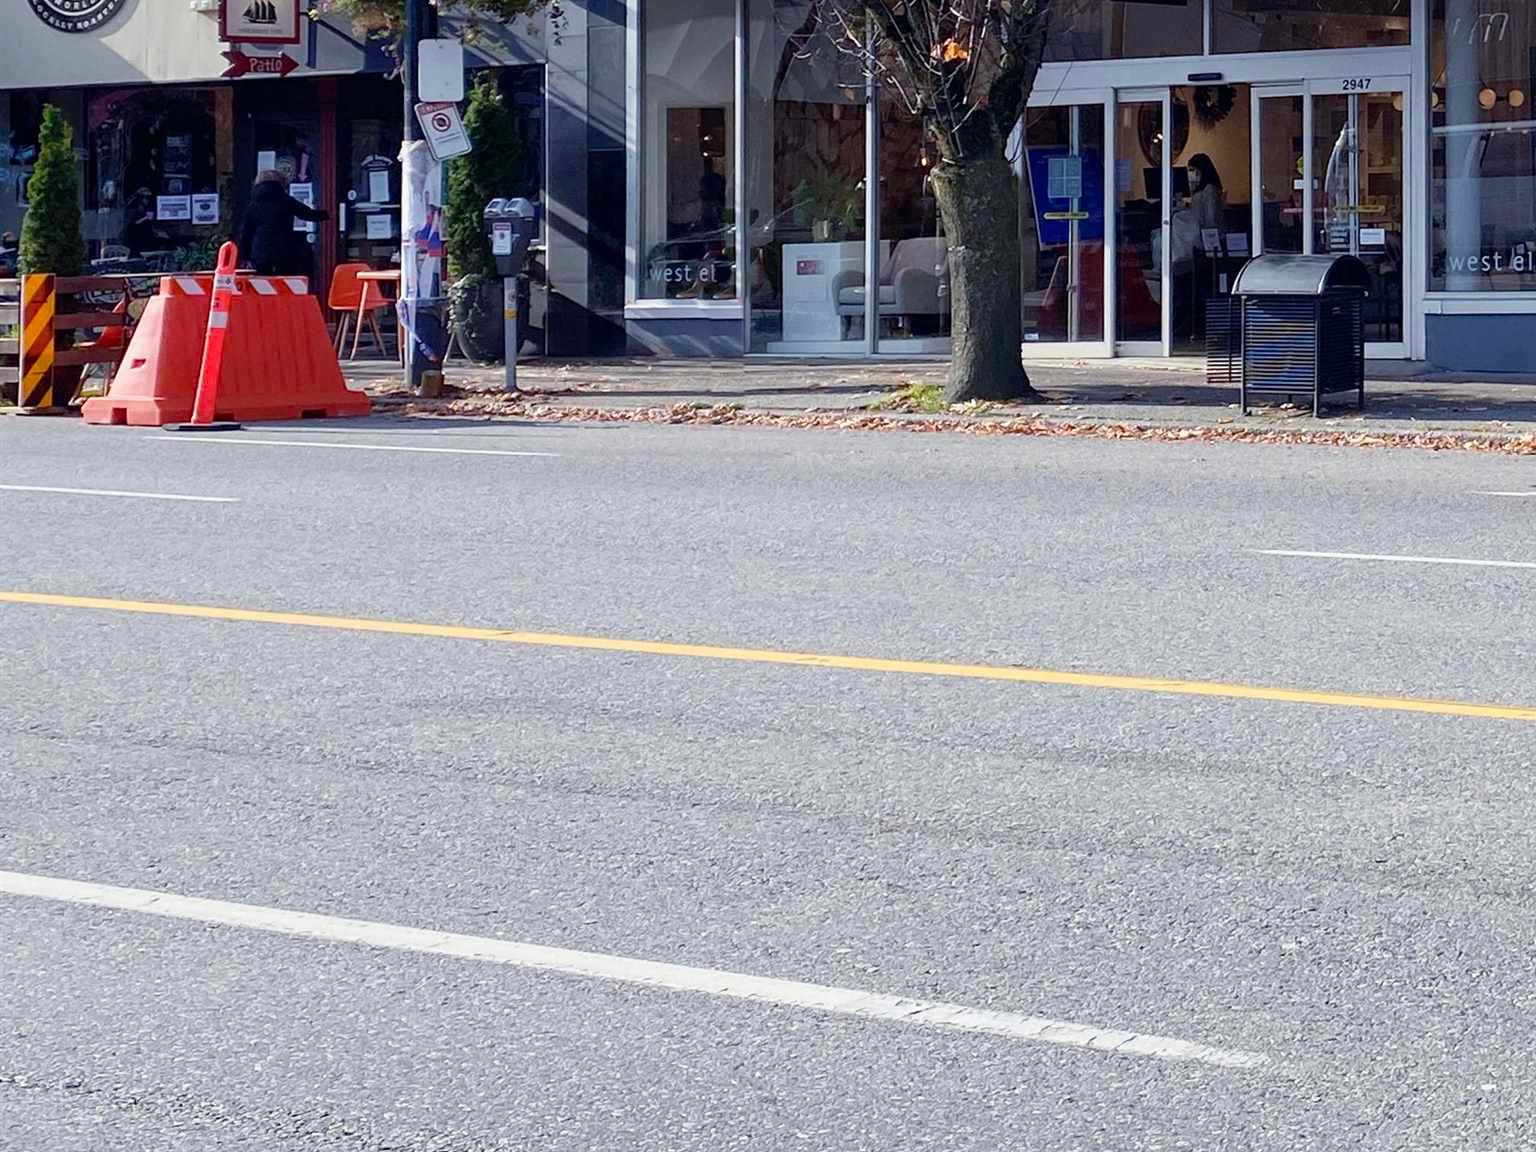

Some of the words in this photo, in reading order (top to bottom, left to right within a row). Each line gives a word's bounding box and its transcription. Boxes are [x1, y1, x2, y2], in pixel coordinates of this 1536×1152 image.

[249, 58, 283, 72] Patio
[1342, 78, 1371, 90] 2947
[1449, 251, 1502, 271] west
[650, 264, 692, 282] west
